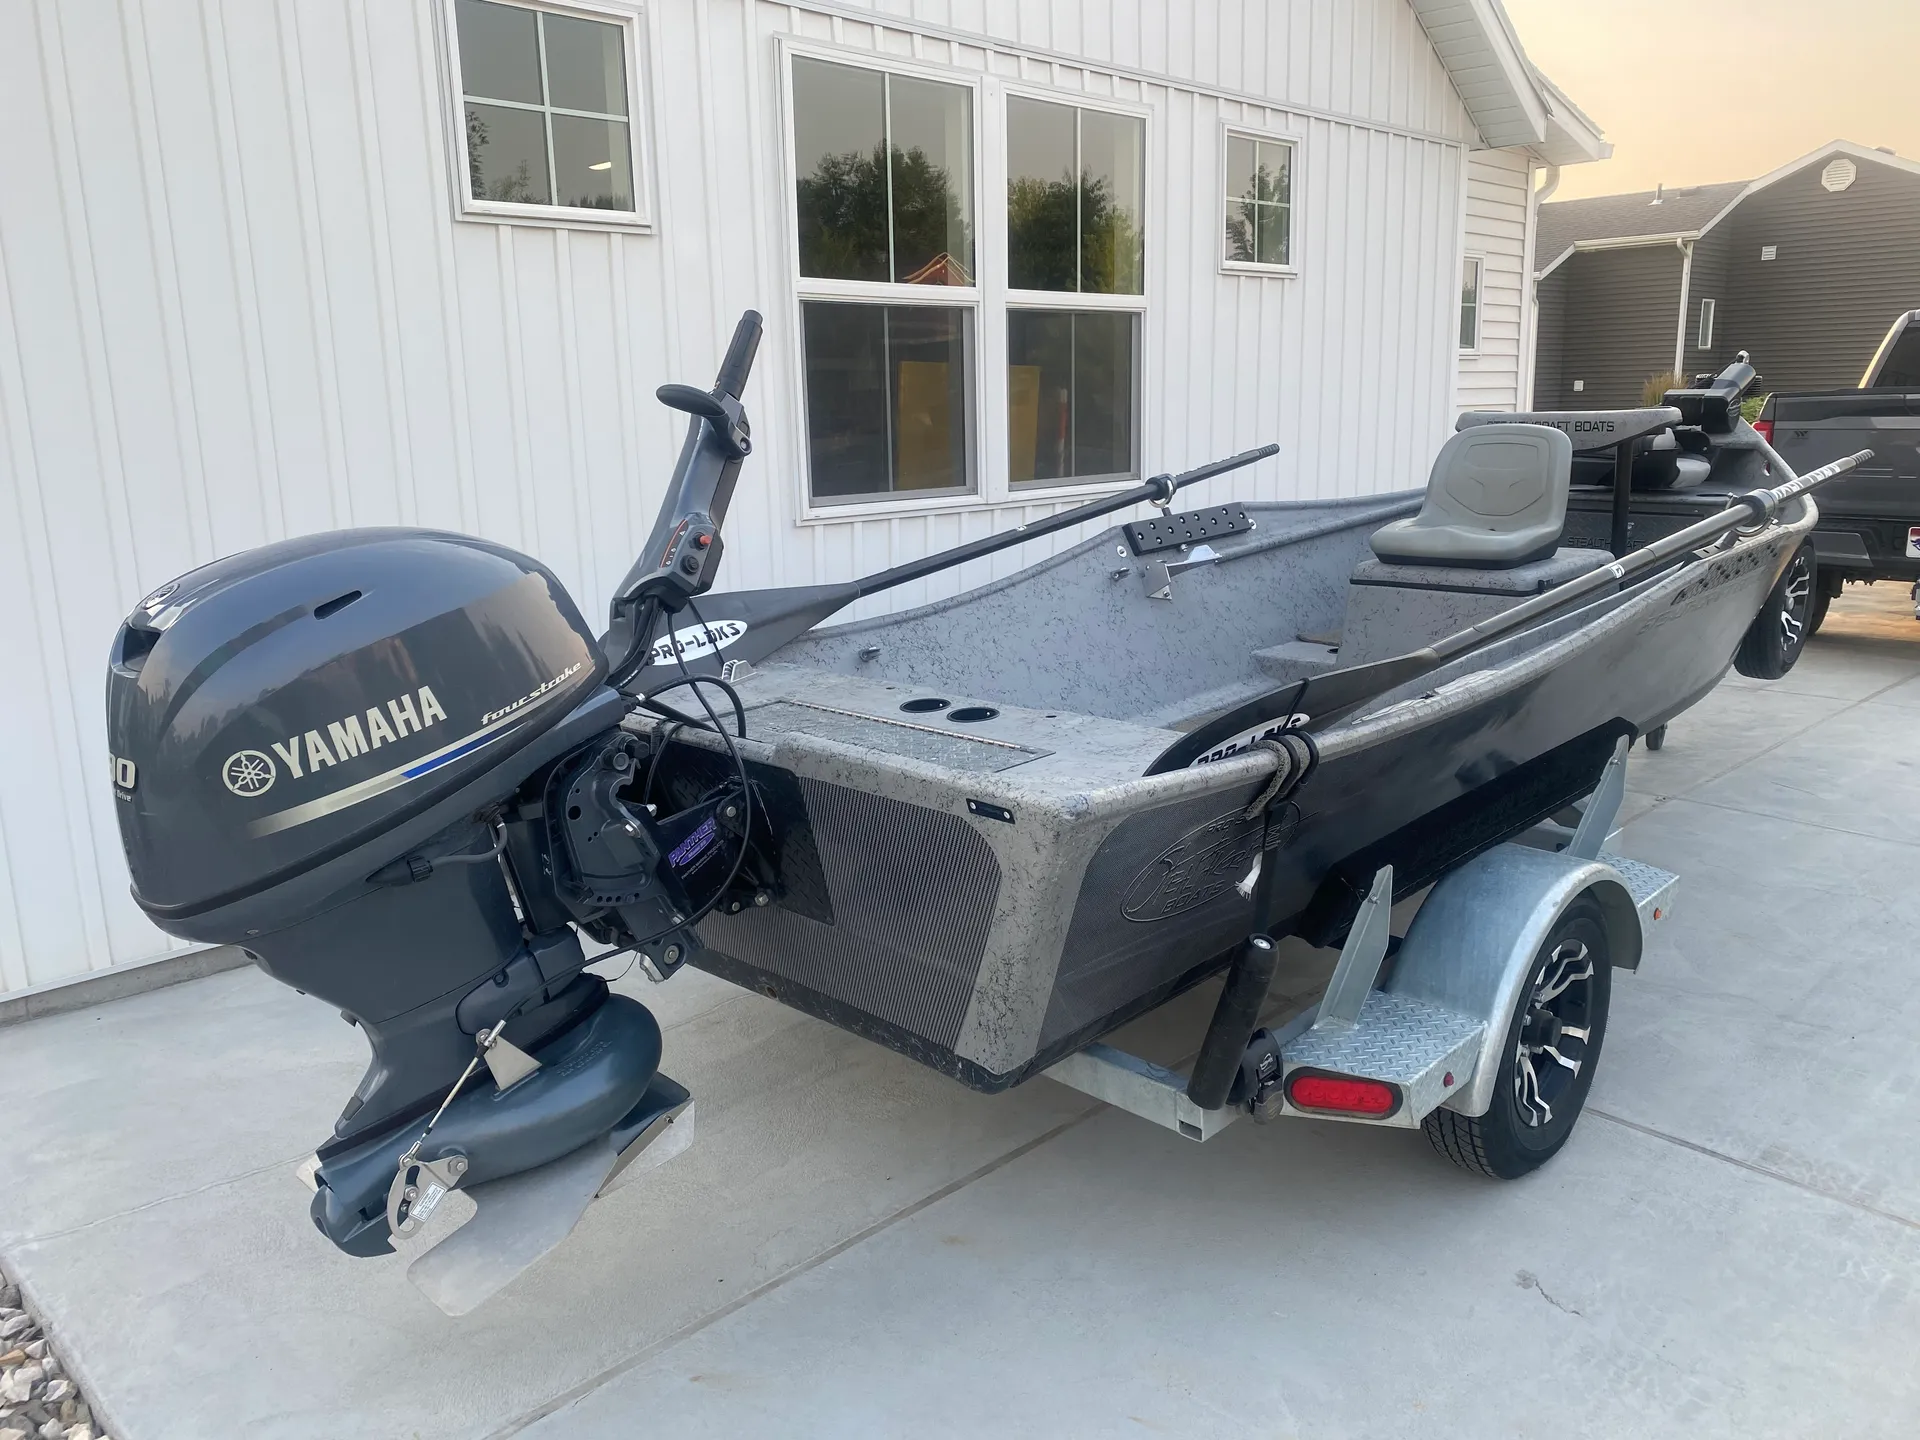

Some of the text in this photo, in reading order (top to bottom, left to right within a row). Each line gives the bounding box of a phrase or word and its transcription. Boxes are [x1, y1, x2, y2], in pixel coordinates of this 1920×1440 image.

[1574, 420, 1615, 432] BOATS
[270, 685, 448, 780] YAMAHA
[667, 816, 717, 868] PANTHER
